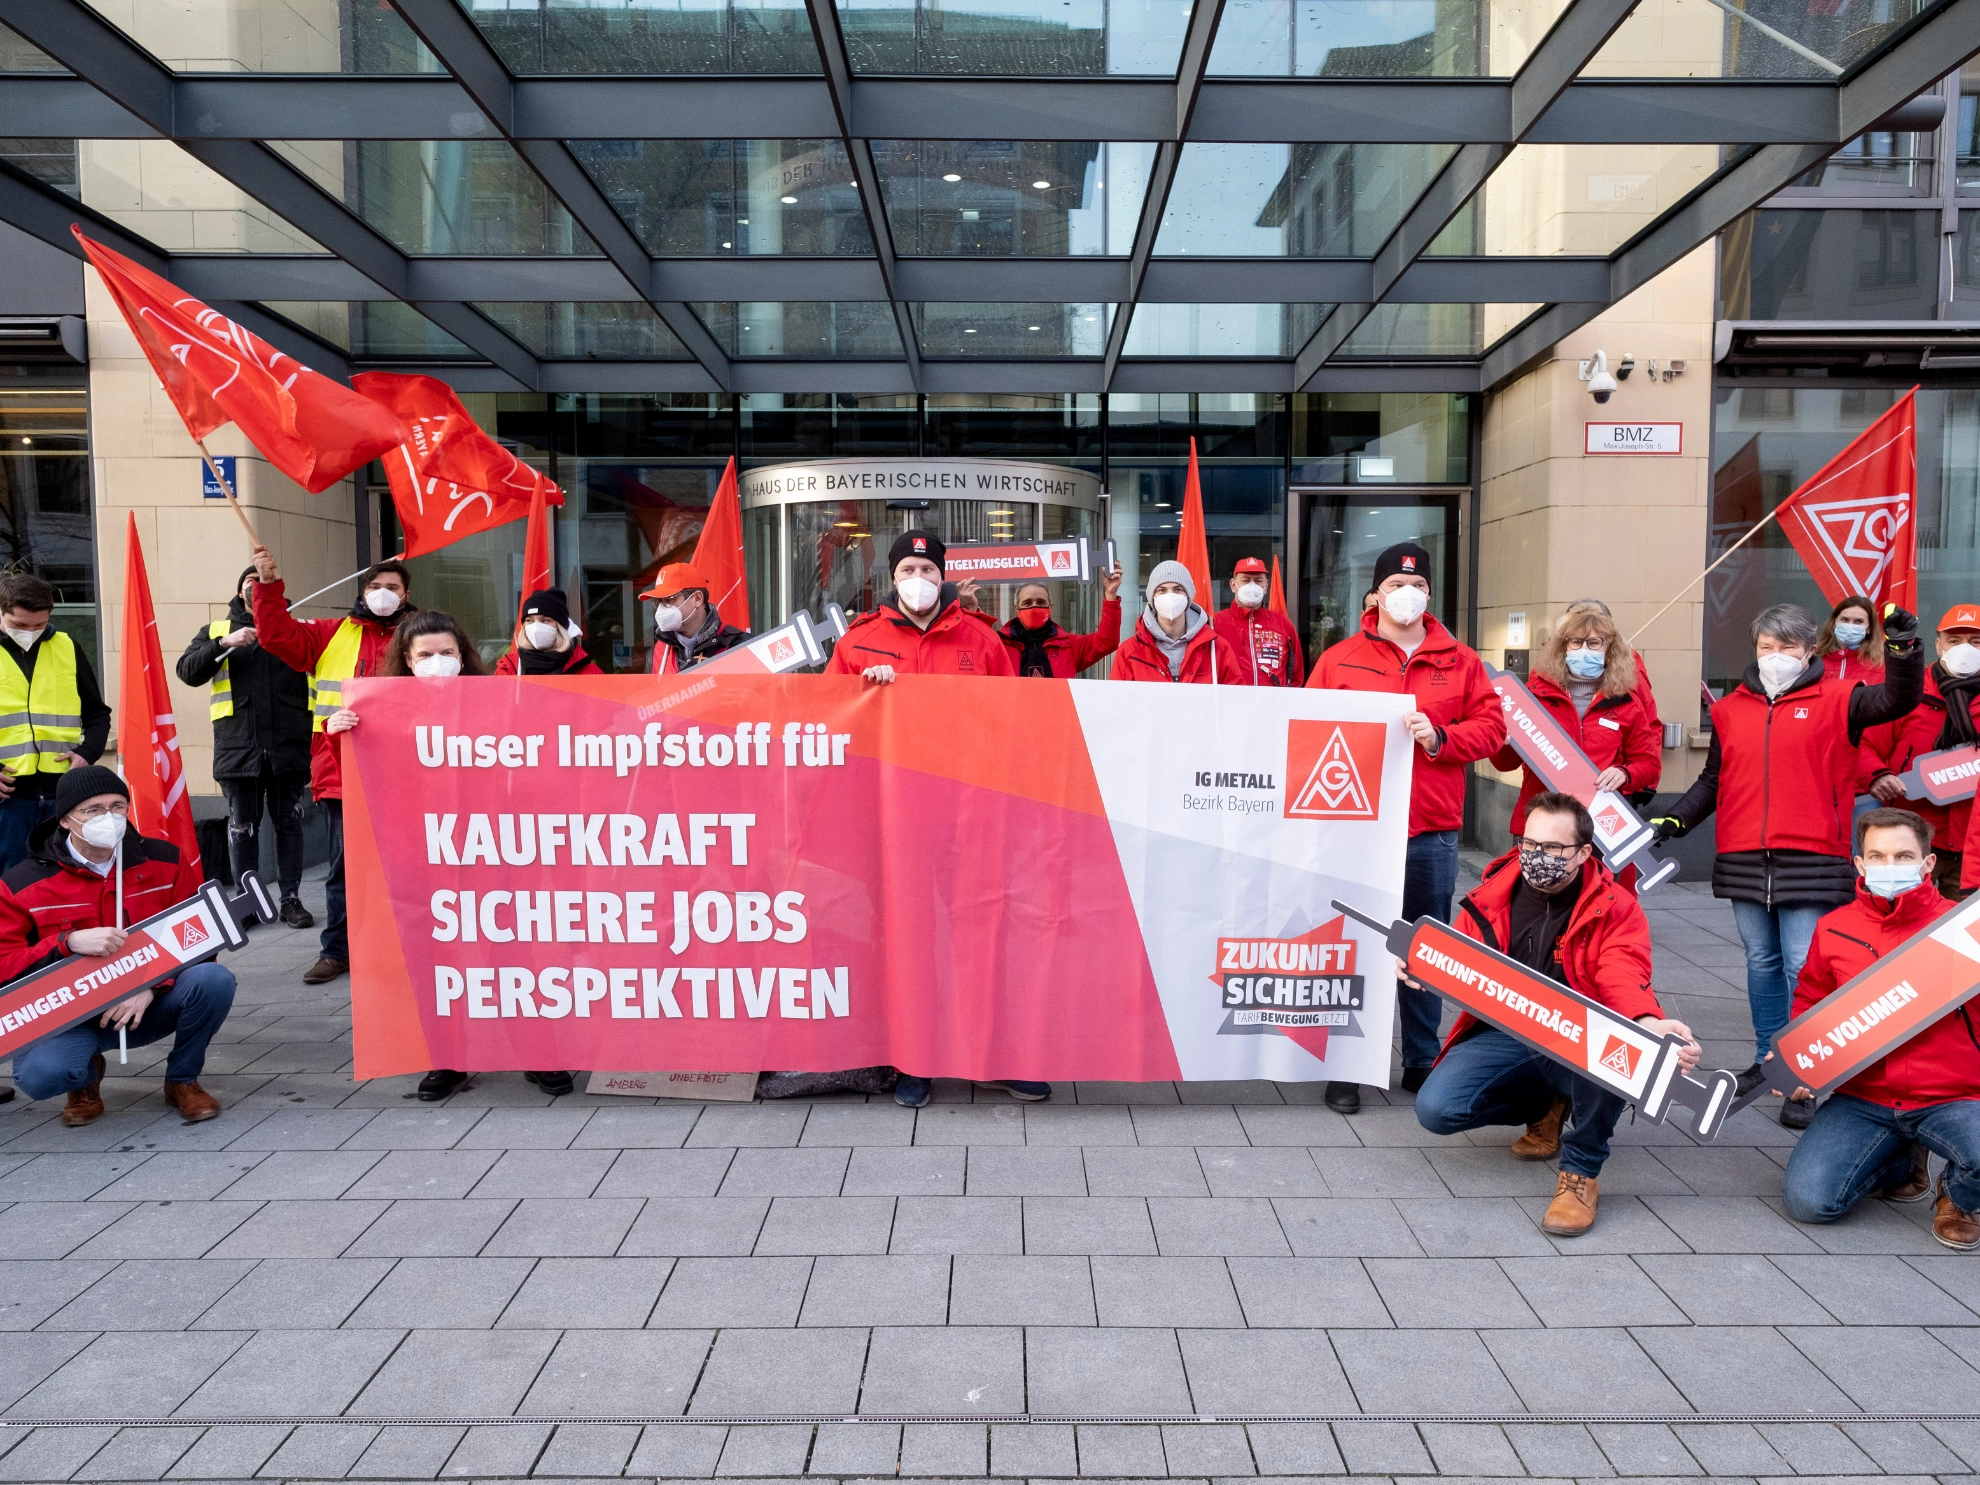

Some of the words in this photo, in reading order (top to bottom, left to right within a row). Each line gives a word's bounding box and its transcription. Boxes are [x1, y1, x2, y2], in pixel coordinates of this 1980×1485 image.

[1614, 427, 1653, 442] BMZ
[752, 479, 782, 497] HAUS
[786, 476, 817, 492] DER
[826, 473, 966, 490] BAYERISCHEN
[977, 475, 1076, 497] WIRTSCHAFT
[636, 675, 718, 721] ÜBERNAHME
[415, 725, 544, 768] Unser
[557, 722, 772, 777] Impfstoff
[782, 722, 851, 767] für
[1511, 707, 1569, 771] VOLUMEN
[1183, 793, 1224, 811] Bezirk
[1228, 795, 1275, 815] Bayern
[1195, 771, 1212, 786] IG
[1214, 772, 1276, 789] METALL
[424, 813, 756, 866] KAUFKRAFT
[430, 889, 658, 942] SICHERE
[669, 890, 807, 956] JOBS
[74, 943, 160, 997] STUNDEN
[1221, 941, 1352, 971] ZUKUNFT
[434, 965, 850, 1020] PERSPEKTIVEN
[1225, 976, 1360, 1006] SICHERN.
[1415, 942, 1584, 1044] ZUKUNFTSVERTRÄGE
[1321, 1012, 1347, 1025] JETZT
[1796, 1052, 1815, 1070] 4
[1808, 1039, 1834, 1061] %
[1826, 980, 1919, 1048] VOLUMEN
